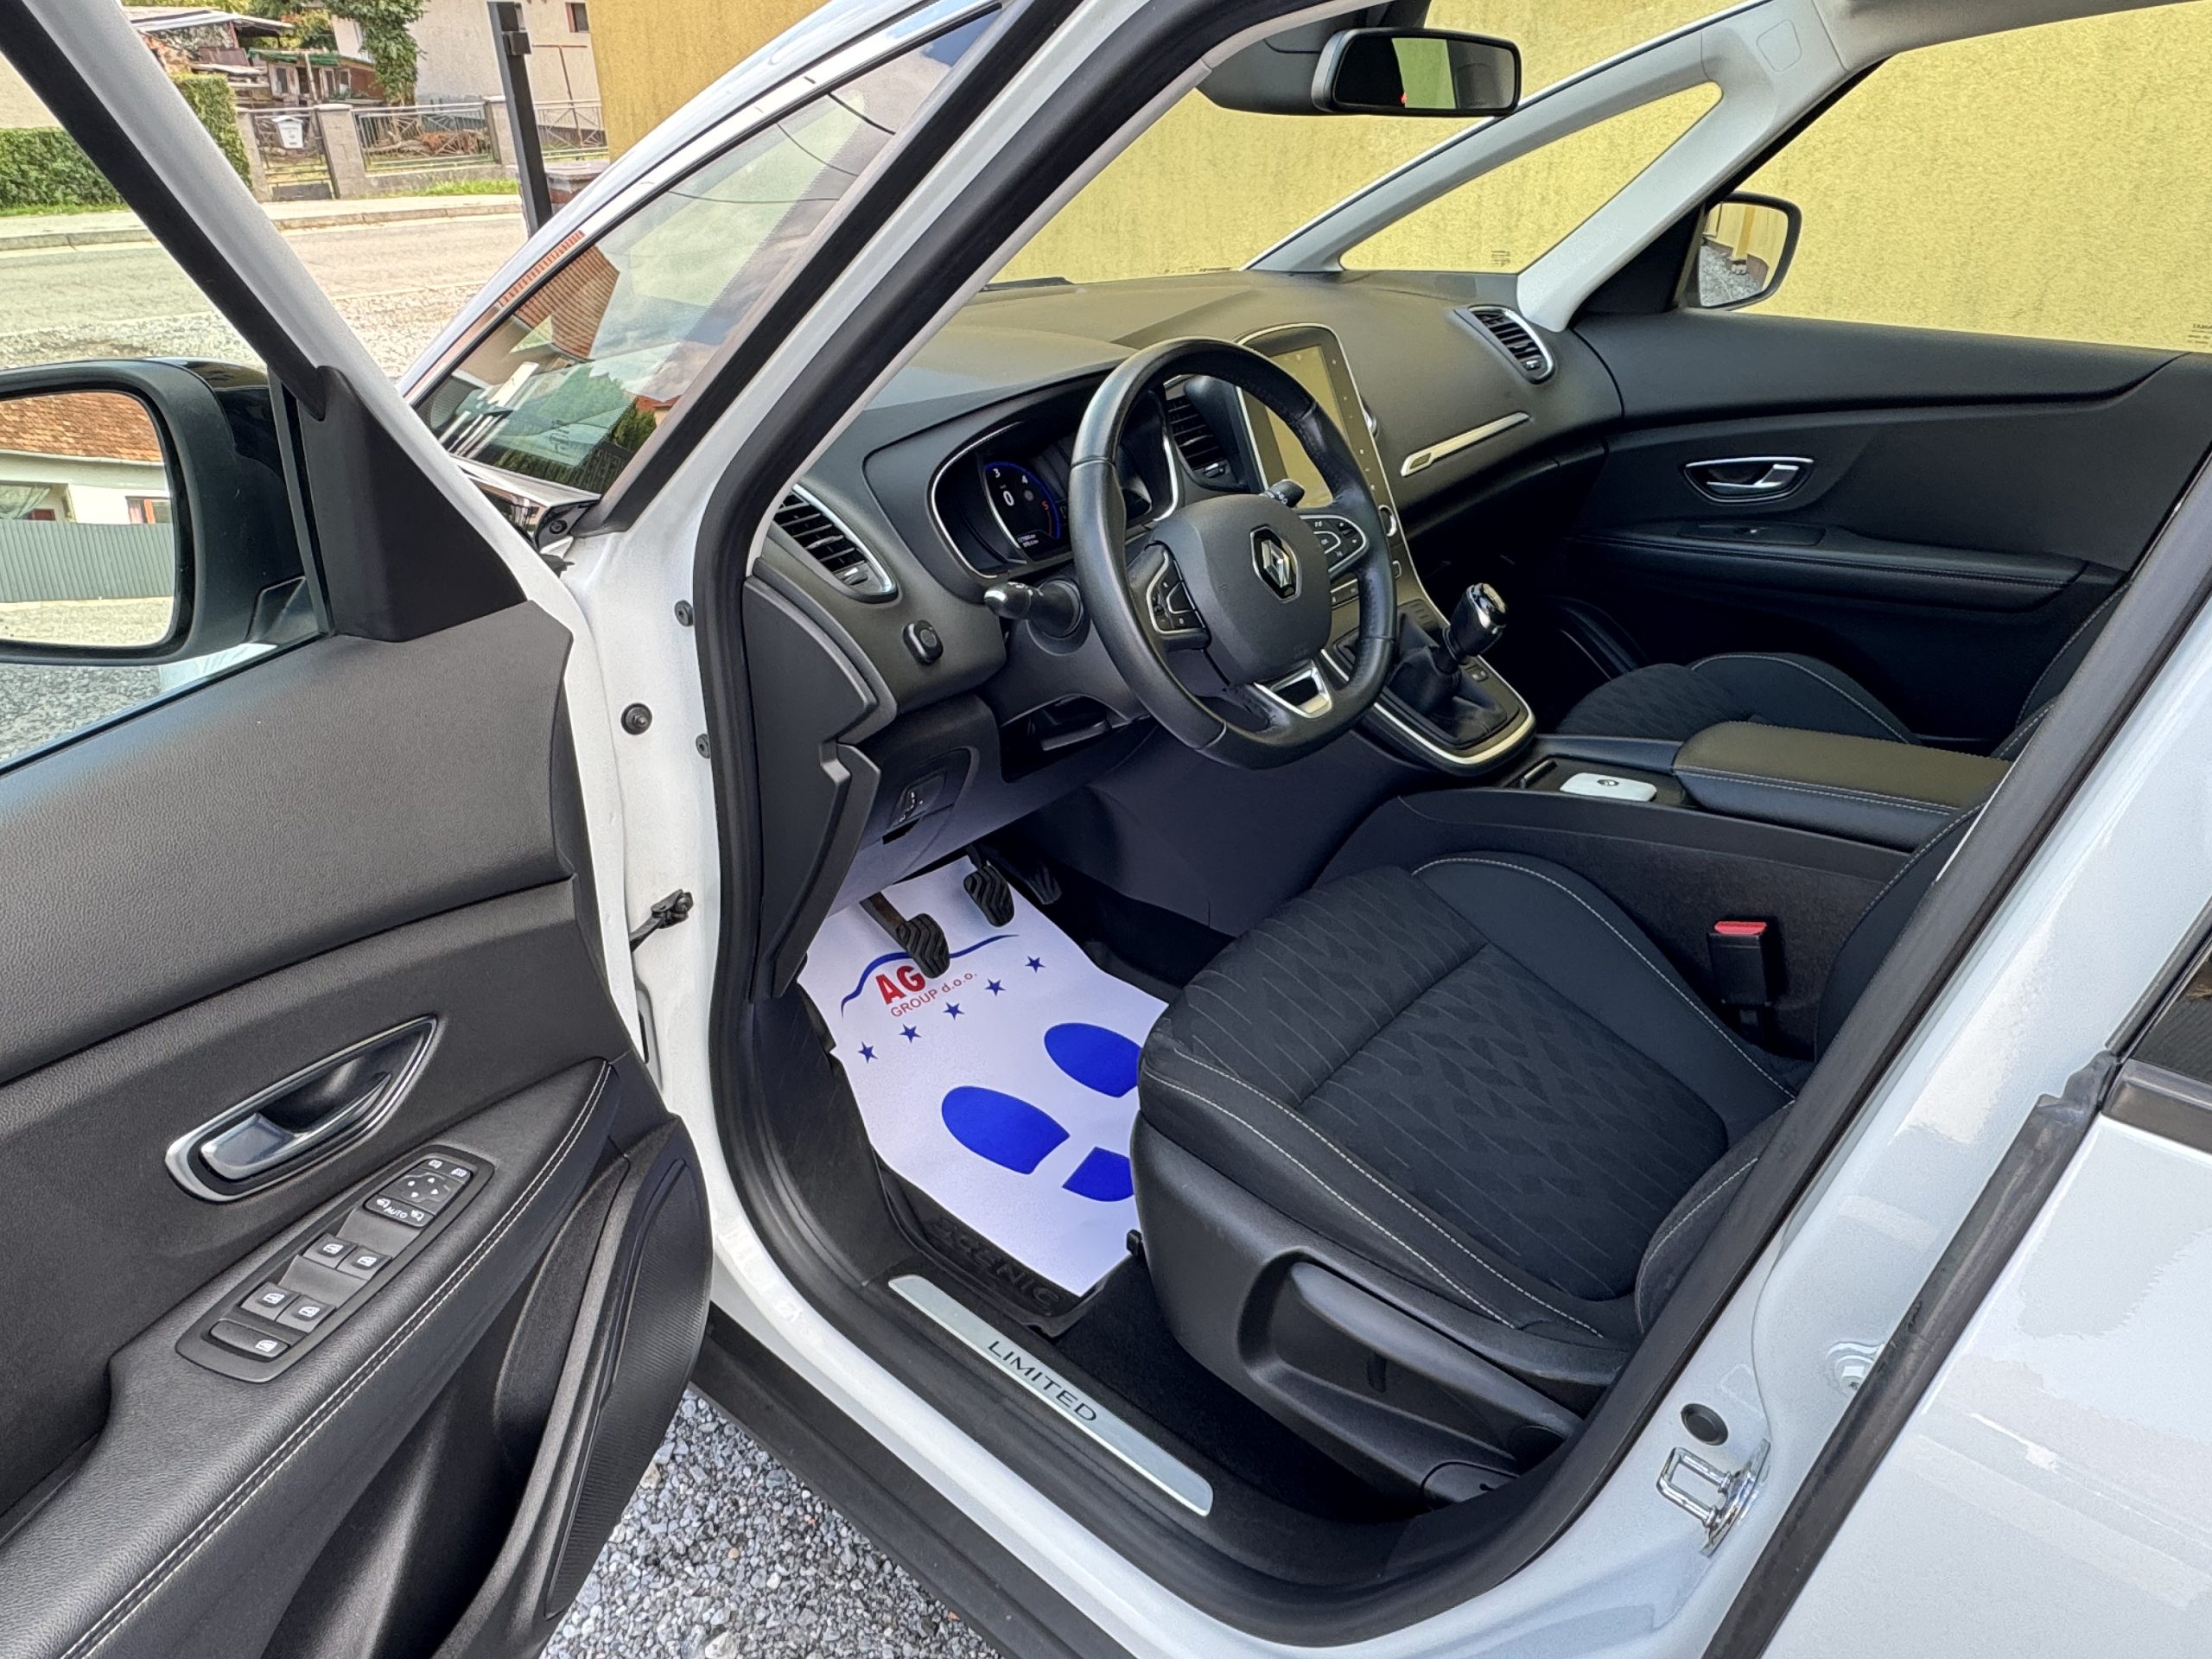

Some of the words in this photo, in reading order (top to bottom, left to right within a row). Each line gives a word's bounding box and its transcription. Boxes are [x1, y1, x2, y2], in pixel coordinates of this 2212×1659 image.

[1002, 490, 1014, 506] 0
[875, 965, 926, 1005] AG
[891, 988, 938, 1017] GROUP
[941, 972, 977, 993] d.o.o.
[383, 1206, 408, 1218] AUTO
[988, 1340, 1097, 1421] LIMITED
